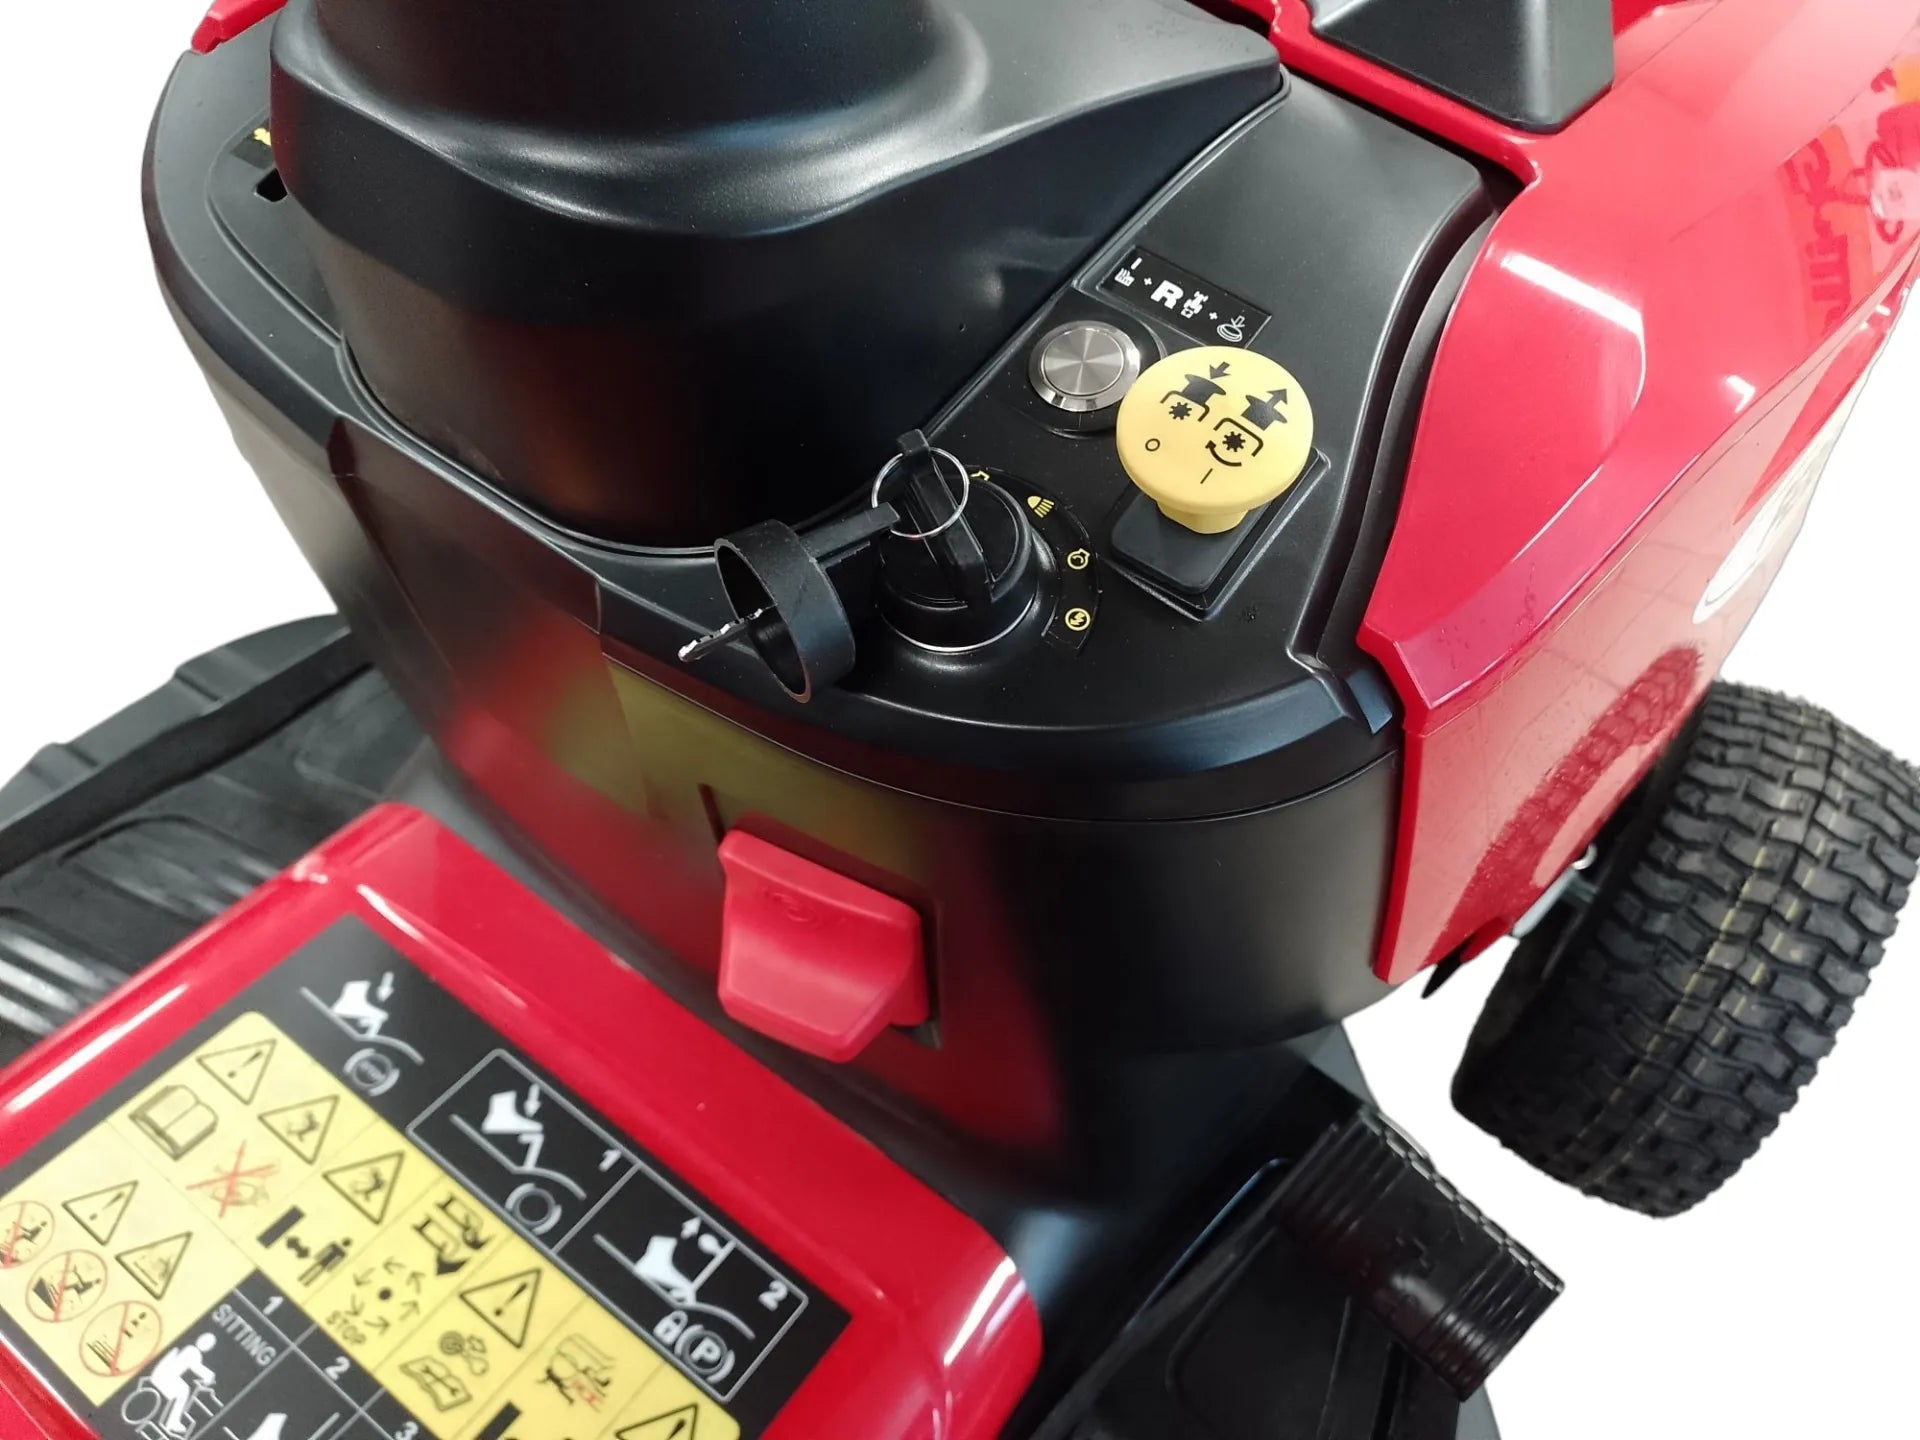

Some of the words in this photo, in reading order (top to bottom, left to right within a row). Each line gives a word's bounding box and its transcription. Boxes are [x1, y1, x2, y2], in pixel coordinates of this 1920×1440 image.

[1151, 280, 1184, 310] R
[599, 1150, 622, 1172] 1
[262, 1296, 284, 1315] 1
[758, 1279, 788, 1311] 2
[212, 1303, 277, 1367] SITTING
[326, 1310, 366, 1345] STOP
[691, 1336, 721, 1364] P
[324, 1356, 350, 1381] 2
